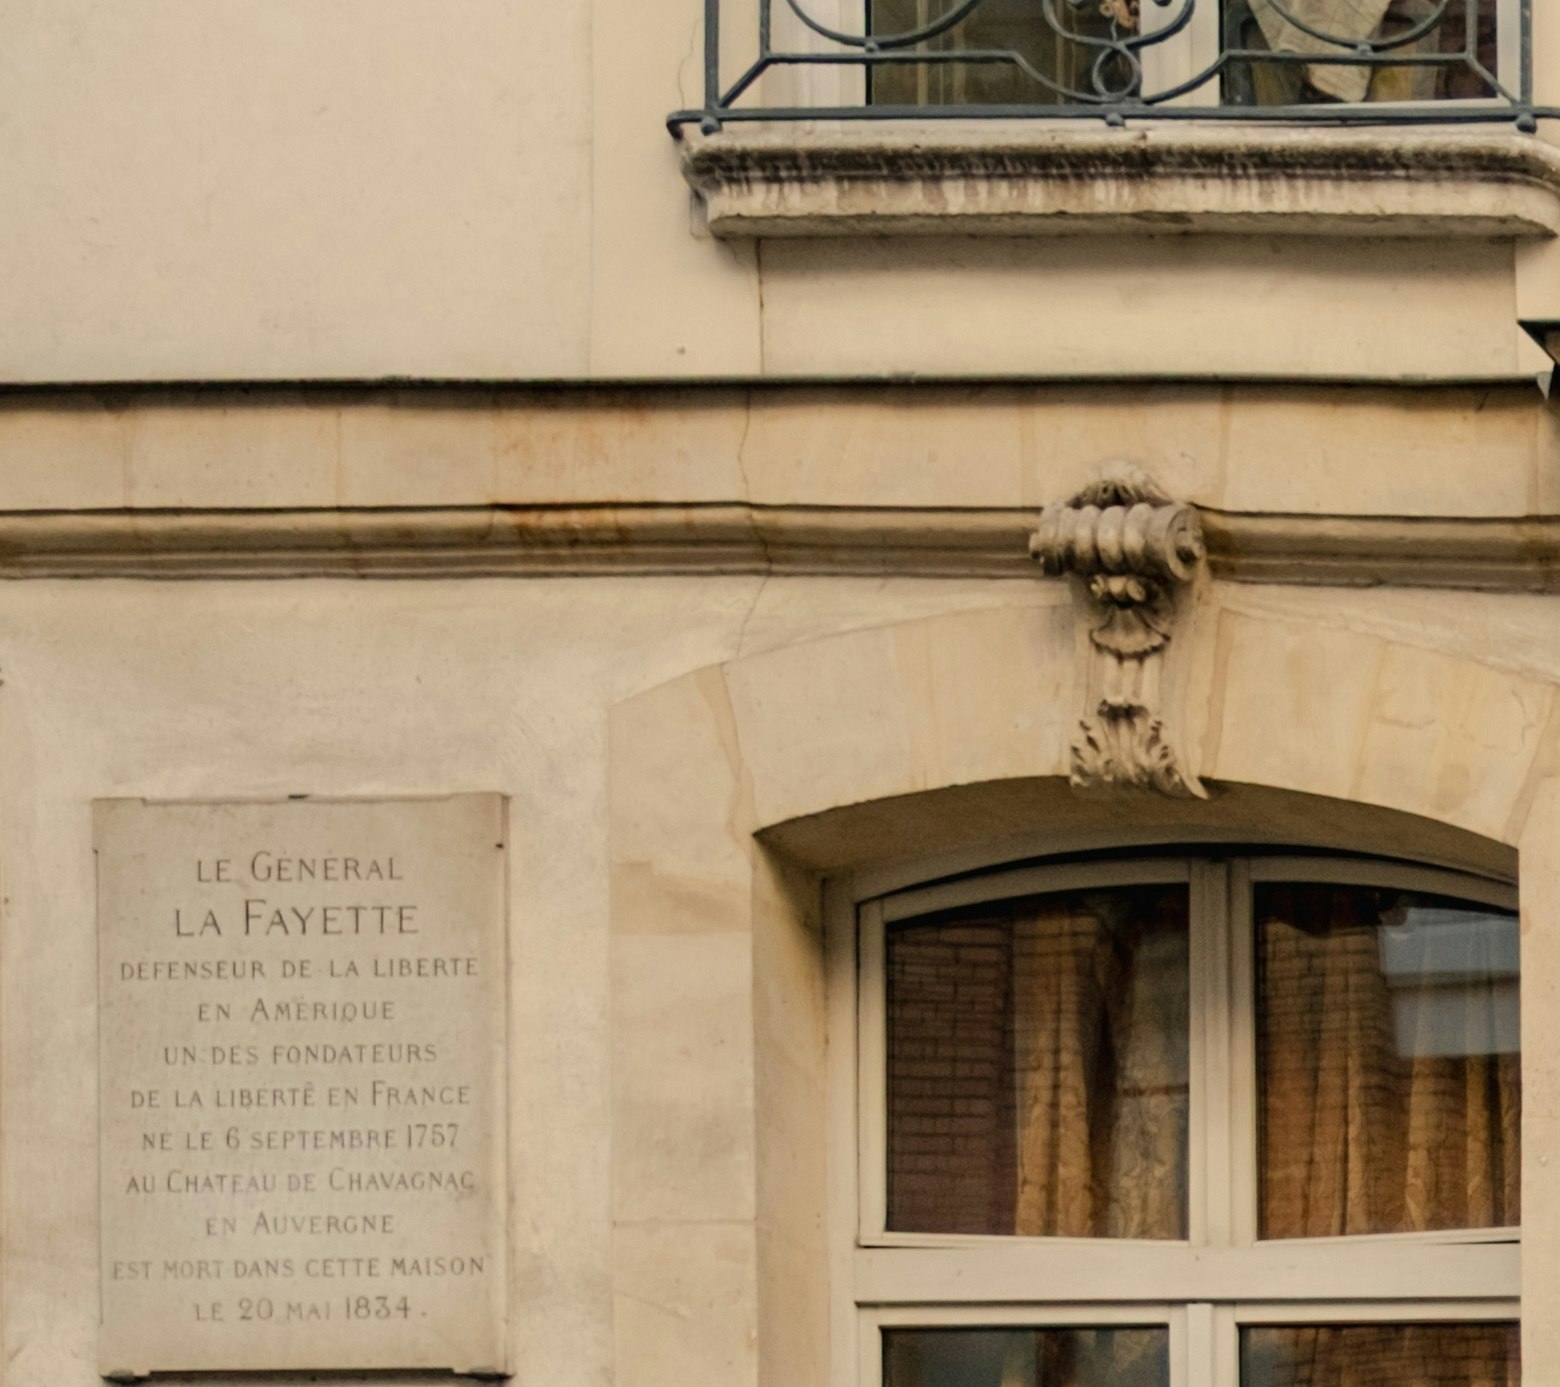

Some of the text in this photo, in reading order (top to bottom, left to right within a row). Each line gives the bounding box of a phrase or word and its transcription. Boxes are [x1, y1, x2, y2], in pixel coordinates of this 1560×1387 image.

[196, 858, 231, 884] LE
[175, 900, 419, 937] LA FAYETTE
[282, 959, 312, 979] DE
[329, 958, 359, 978] LA
[199, 1004, 232, 1022] EN
[164, 1044, 437, 1065] UN DES FONDATEURS
[131, 1089, 159, 1108] DE
[174, 1089, 202, 1107] LA
[328, 1087, 357, 1106] EN
[372, 1081, 470, 1106] FRANCE
[186, 1133, 212, 1150] LE
[226, 1127, 240, 1149] 6
[251, 1130, 397, 1150] SEPTEMBRE
[407, 1124, 459, 1149] 1757
[126, 1174, 156, 1194] AU
[288, 1173, 316, 1193] DE
[329, 1167, 475, 1192] CHAVAGNAC
[206, 1212, 394, 1236] EN AUVERGNE
[113, 1257, 483, 1280] EST MORT DANS CETTE MAISON
[195, 1303, 224, 1321] LE
[239, 1298, 274, 1321] 20
[287, 1302, 330, 1320] MAI
